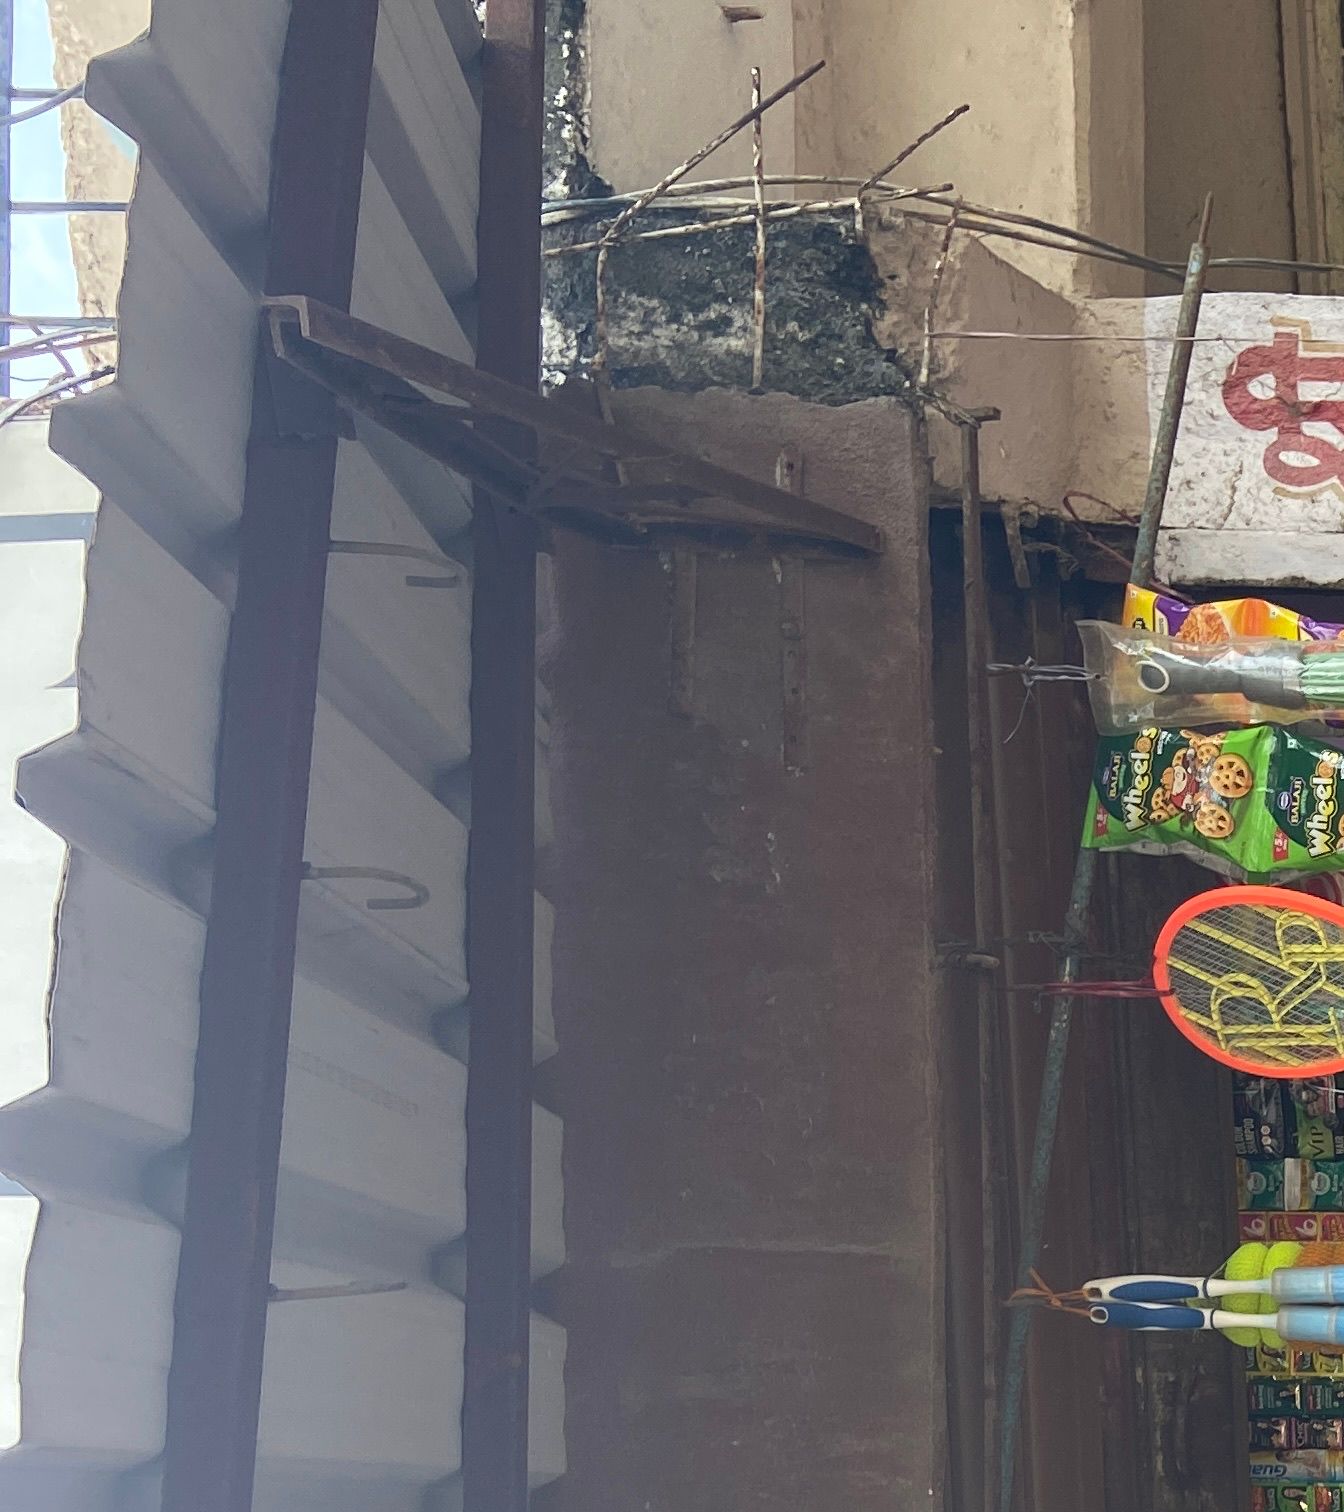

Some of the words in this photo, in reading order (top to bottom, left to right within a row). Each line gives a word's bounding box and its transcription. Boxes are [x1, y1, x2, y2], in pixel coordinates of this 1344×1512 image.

[1109, 755, 1122, 797] BALAJI
[1291, 780, 1303, 823] BALAJI
[1307, 1126, 1326, 1158] VIP
